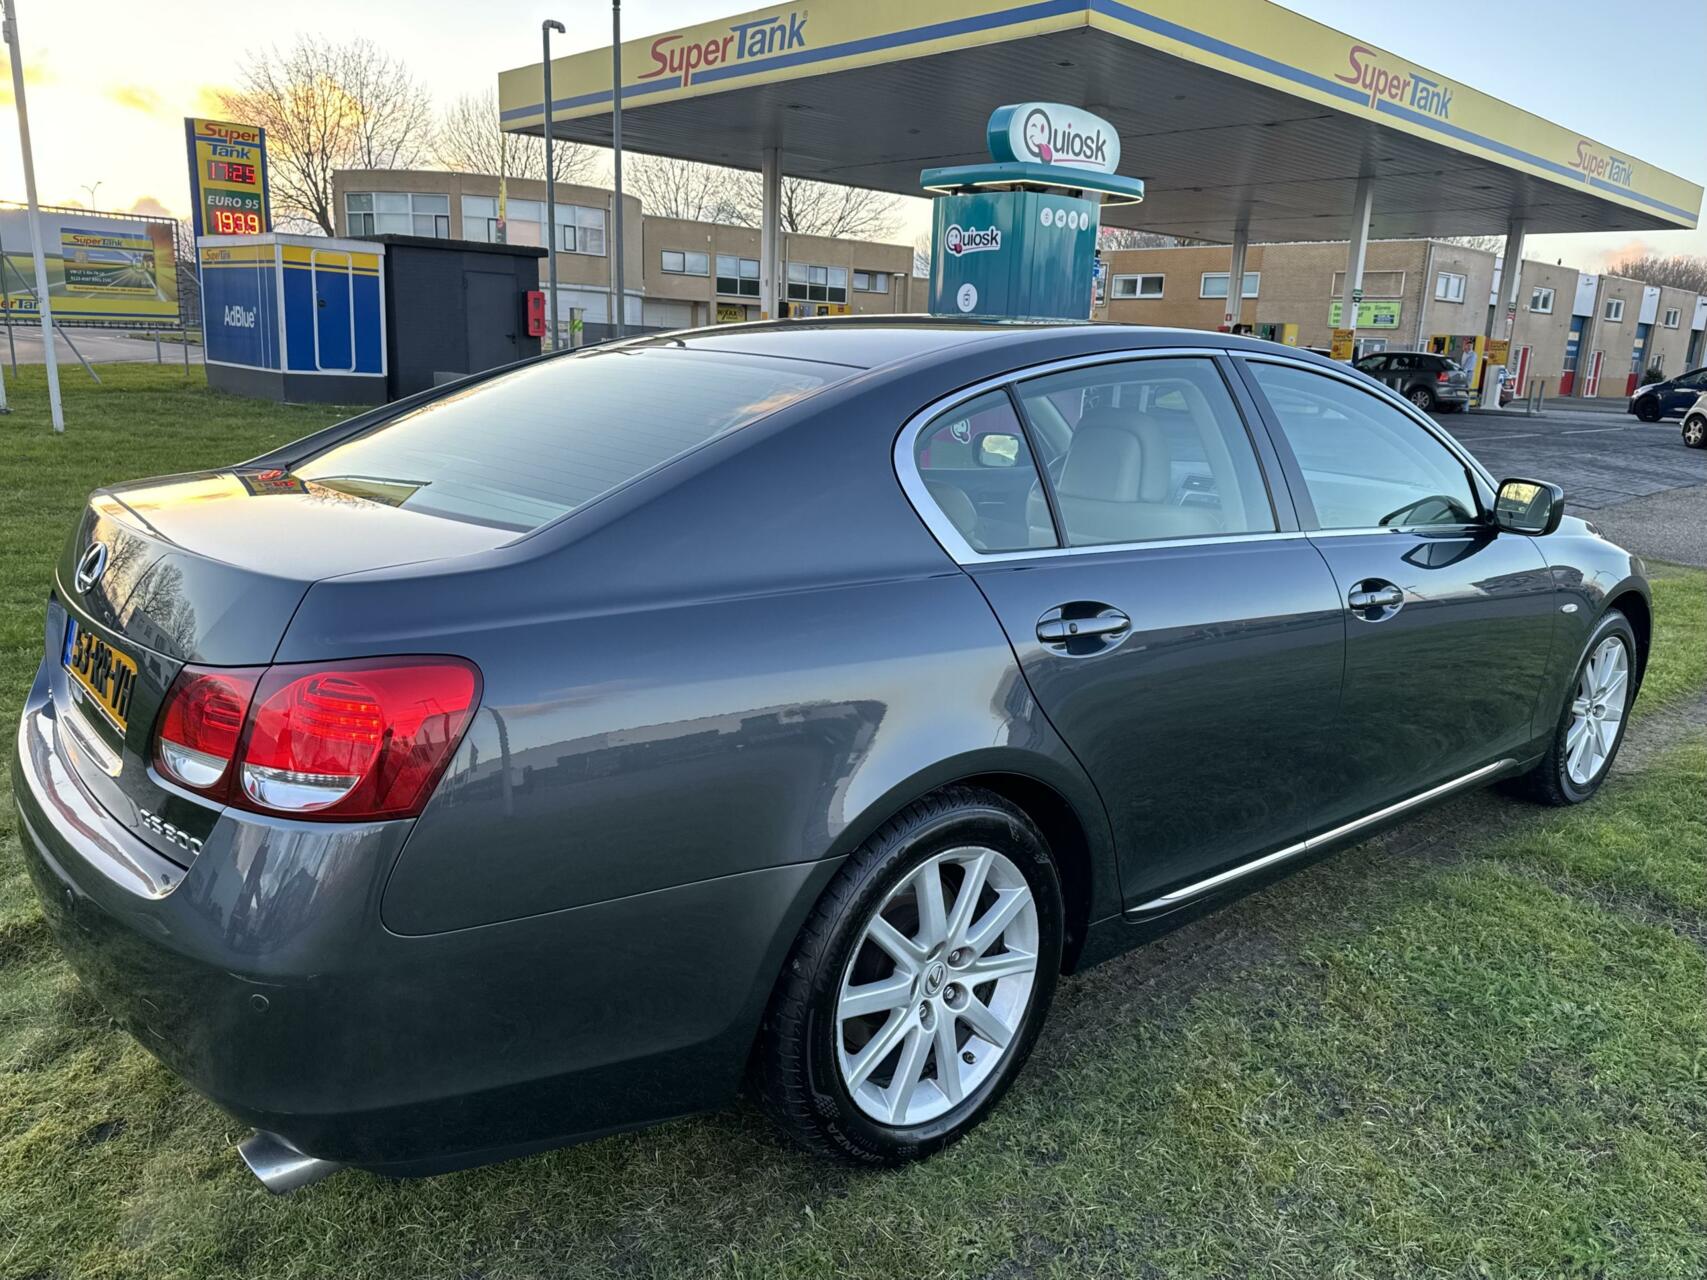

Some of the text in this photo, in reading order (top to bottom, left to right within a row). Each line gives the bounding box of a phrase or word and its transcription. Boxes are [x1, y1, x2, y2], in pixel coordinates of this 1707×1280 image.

[637, 12, 808, 87] SuperTank
[1334, 45, 1452, 119] SuperTank
[197, 122, 259, 144] Super
[1023, 108, 1107, 163] Quiosk
[207, 143, 251, 159] Tank
[1568, 140, 1633, 187] SuperTank
[211, 162, 256, 183] 17:25
[207, 195, 260, 210] EURO 95
[73, 235, 123, 247] SuperTank
[946, 226, 1000, 254] Quiosk
